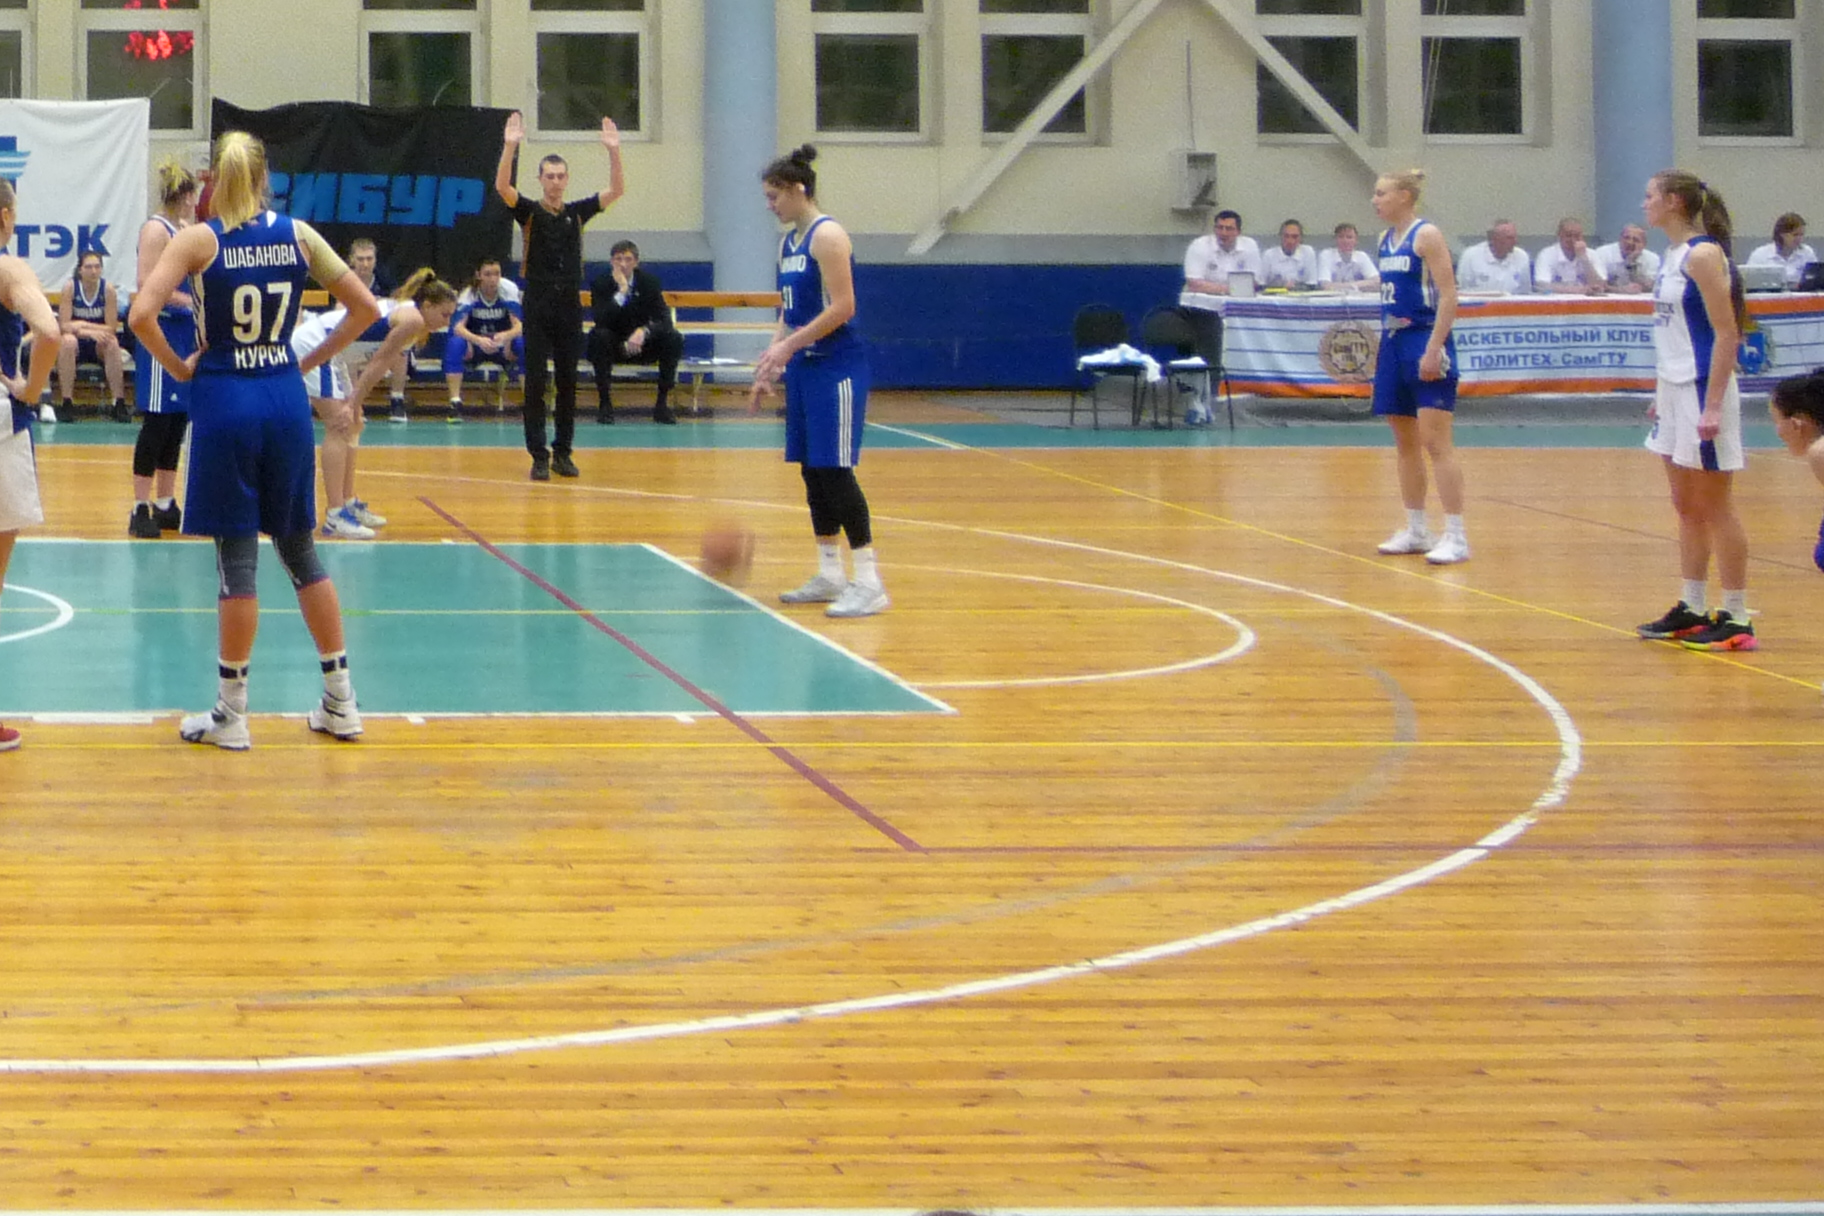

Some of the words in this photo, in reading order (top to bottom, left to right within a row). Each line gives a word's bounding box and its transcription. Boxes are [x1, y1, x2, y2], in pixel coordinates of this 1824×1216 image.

[223, 244, 298, 269] ШАБАНОВА
[233, 281, 292, 344] 97
[1456, 327, 1602, 346] АСКЕТБОЛЬНЫЙ
[1606, 328, 1651, 343] КЛУБ
[235, 345, 289, 370] КУРСК
